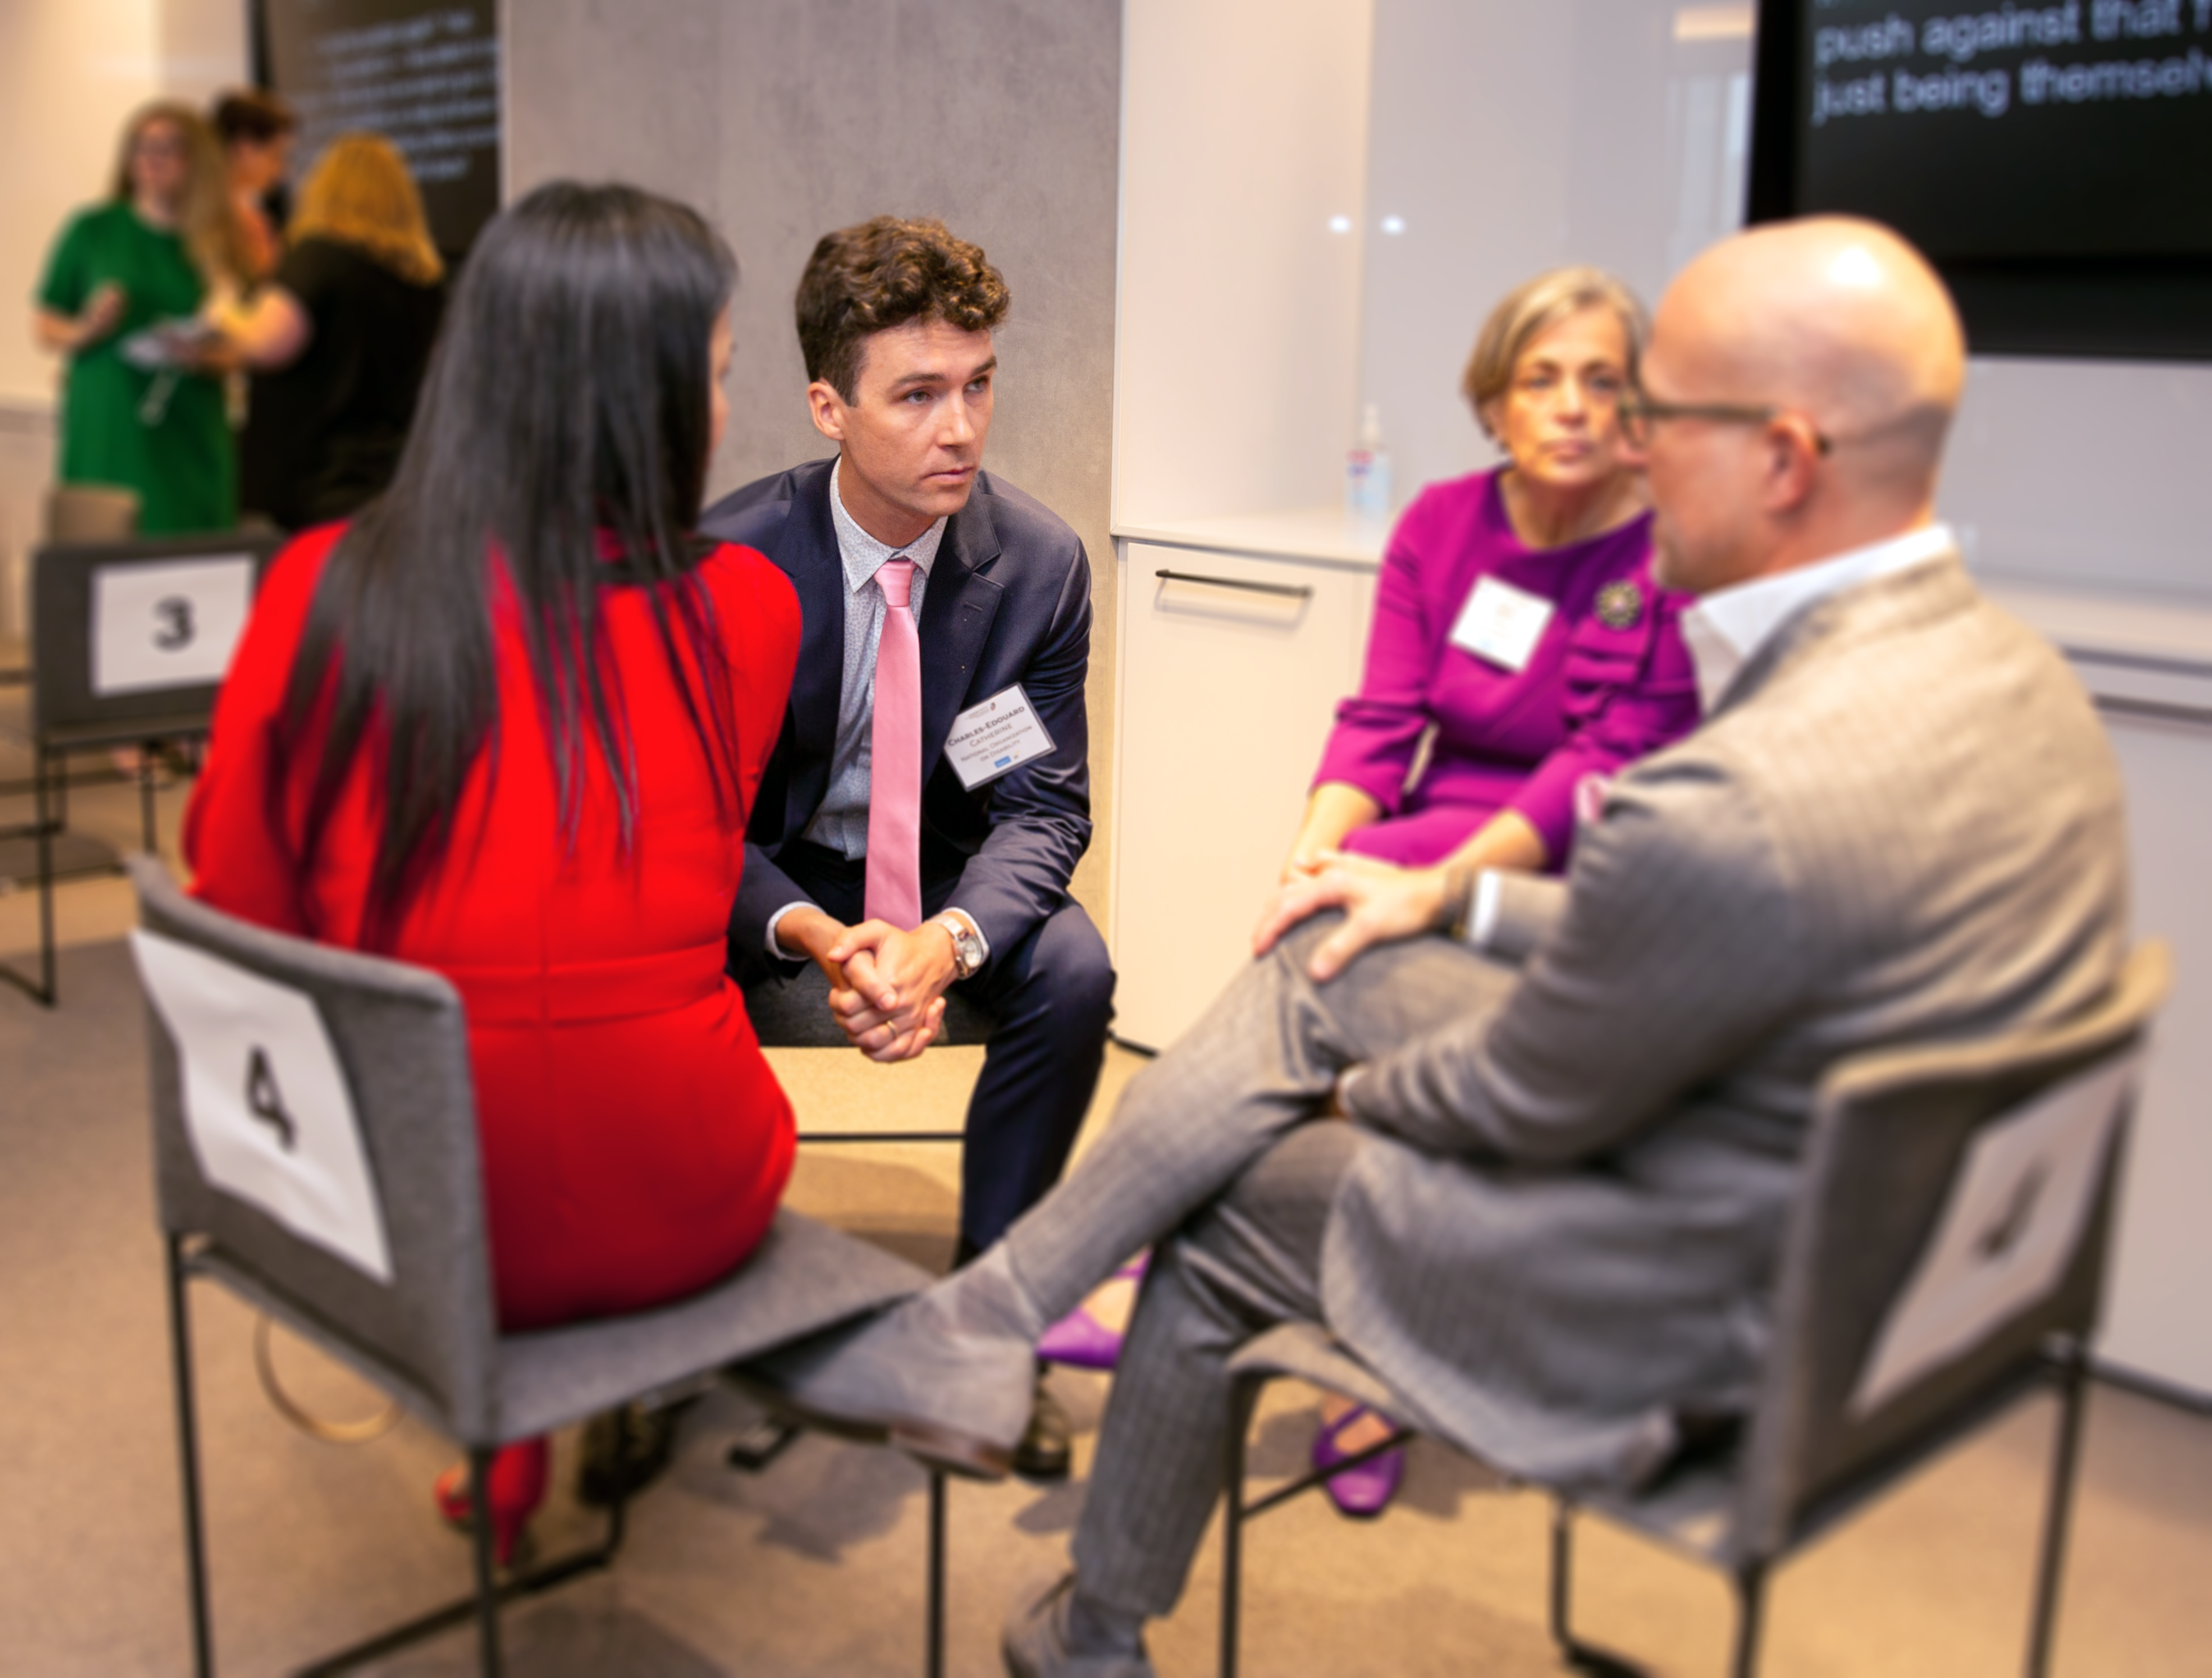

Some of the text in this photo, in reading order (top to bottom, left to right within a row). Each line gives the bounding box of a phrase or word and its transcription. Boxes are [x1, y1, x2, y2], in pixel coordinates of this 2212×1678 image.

[1814, 12, 1915, 68] push
[1922, 1, 2079, 62] against
[2091, 0, 2180, 41] that
[1811, 69, 1886, 127] just
[1894, 63, 2010, 118] being
[152, 594, 196, 653] 3
[948, 706, 1025, 746] CHARLES-EDOUARD
[969, 723, 1013, 747] CATHERINE
[248, 1044, 295, 1152] 4
